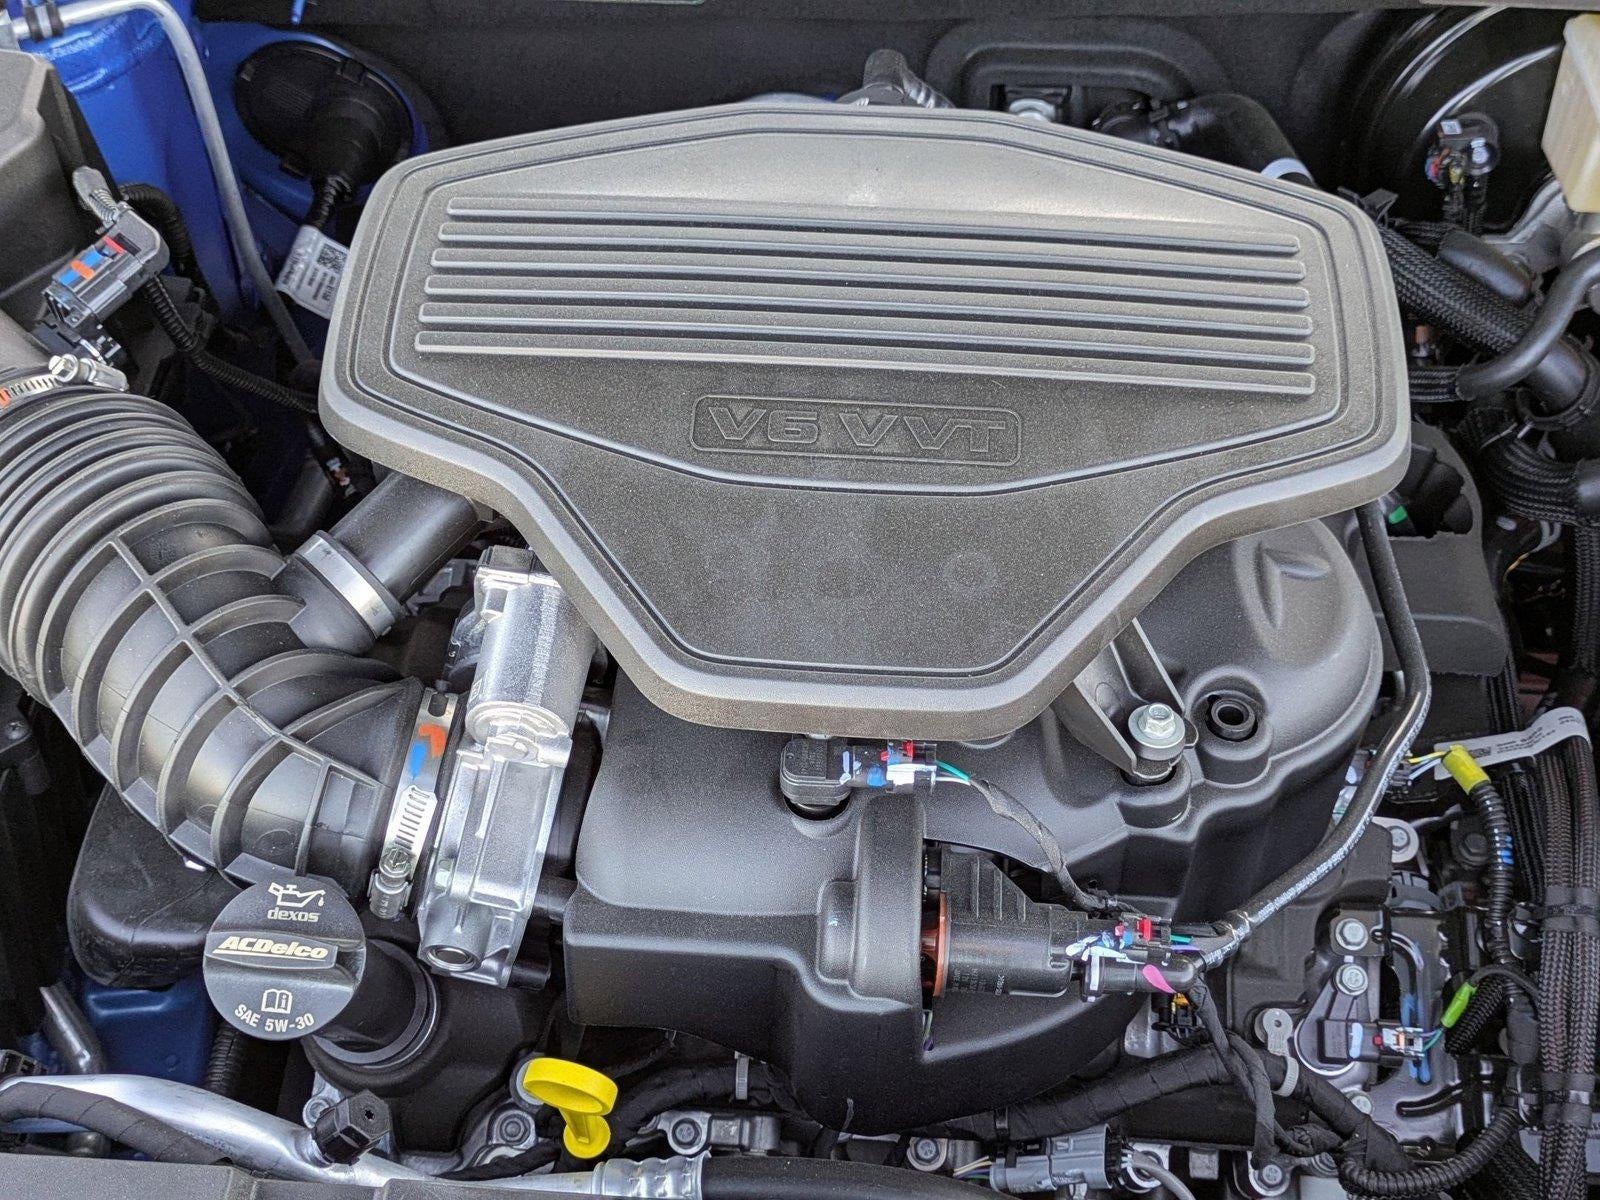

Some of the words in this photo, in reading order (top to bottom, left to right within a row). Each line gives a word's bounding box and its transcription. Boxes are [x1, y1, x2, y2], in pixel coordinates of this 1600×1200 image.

[708, 407, 818, 443] V6
[839, 412, 1006, 453] VVT
[267, 907, 321, 923] dexos
[217, 936, 329, 959] ACDelco
[234, 1004, 261, 1027] SAE
[264, 1013, 315, 1033] 5W-30
